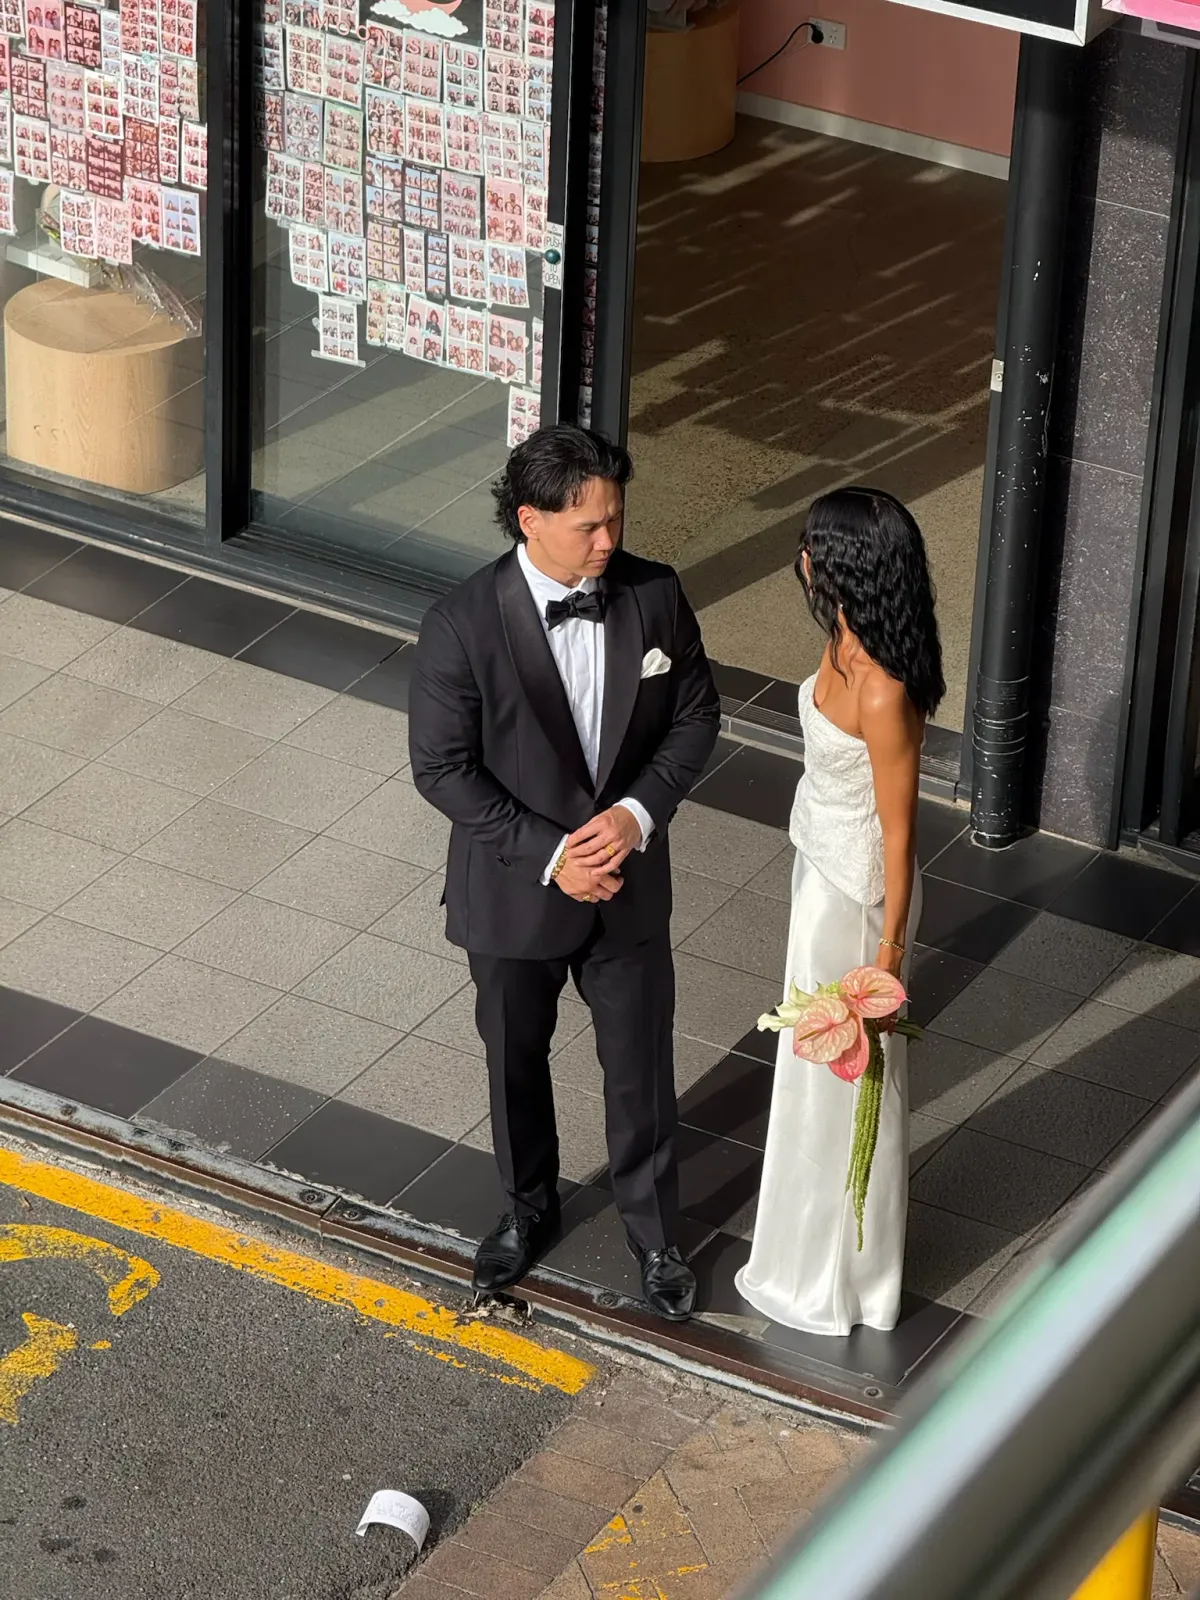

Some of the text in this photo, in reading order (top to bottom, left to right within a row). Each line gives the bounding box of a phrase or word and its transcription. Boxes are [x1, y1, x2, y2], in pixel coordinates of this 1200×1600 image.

[311, 8, 391, 46] MOON
[546, 236, 562, 248] PUSH
[545, 272, 561, 285] OPEN
